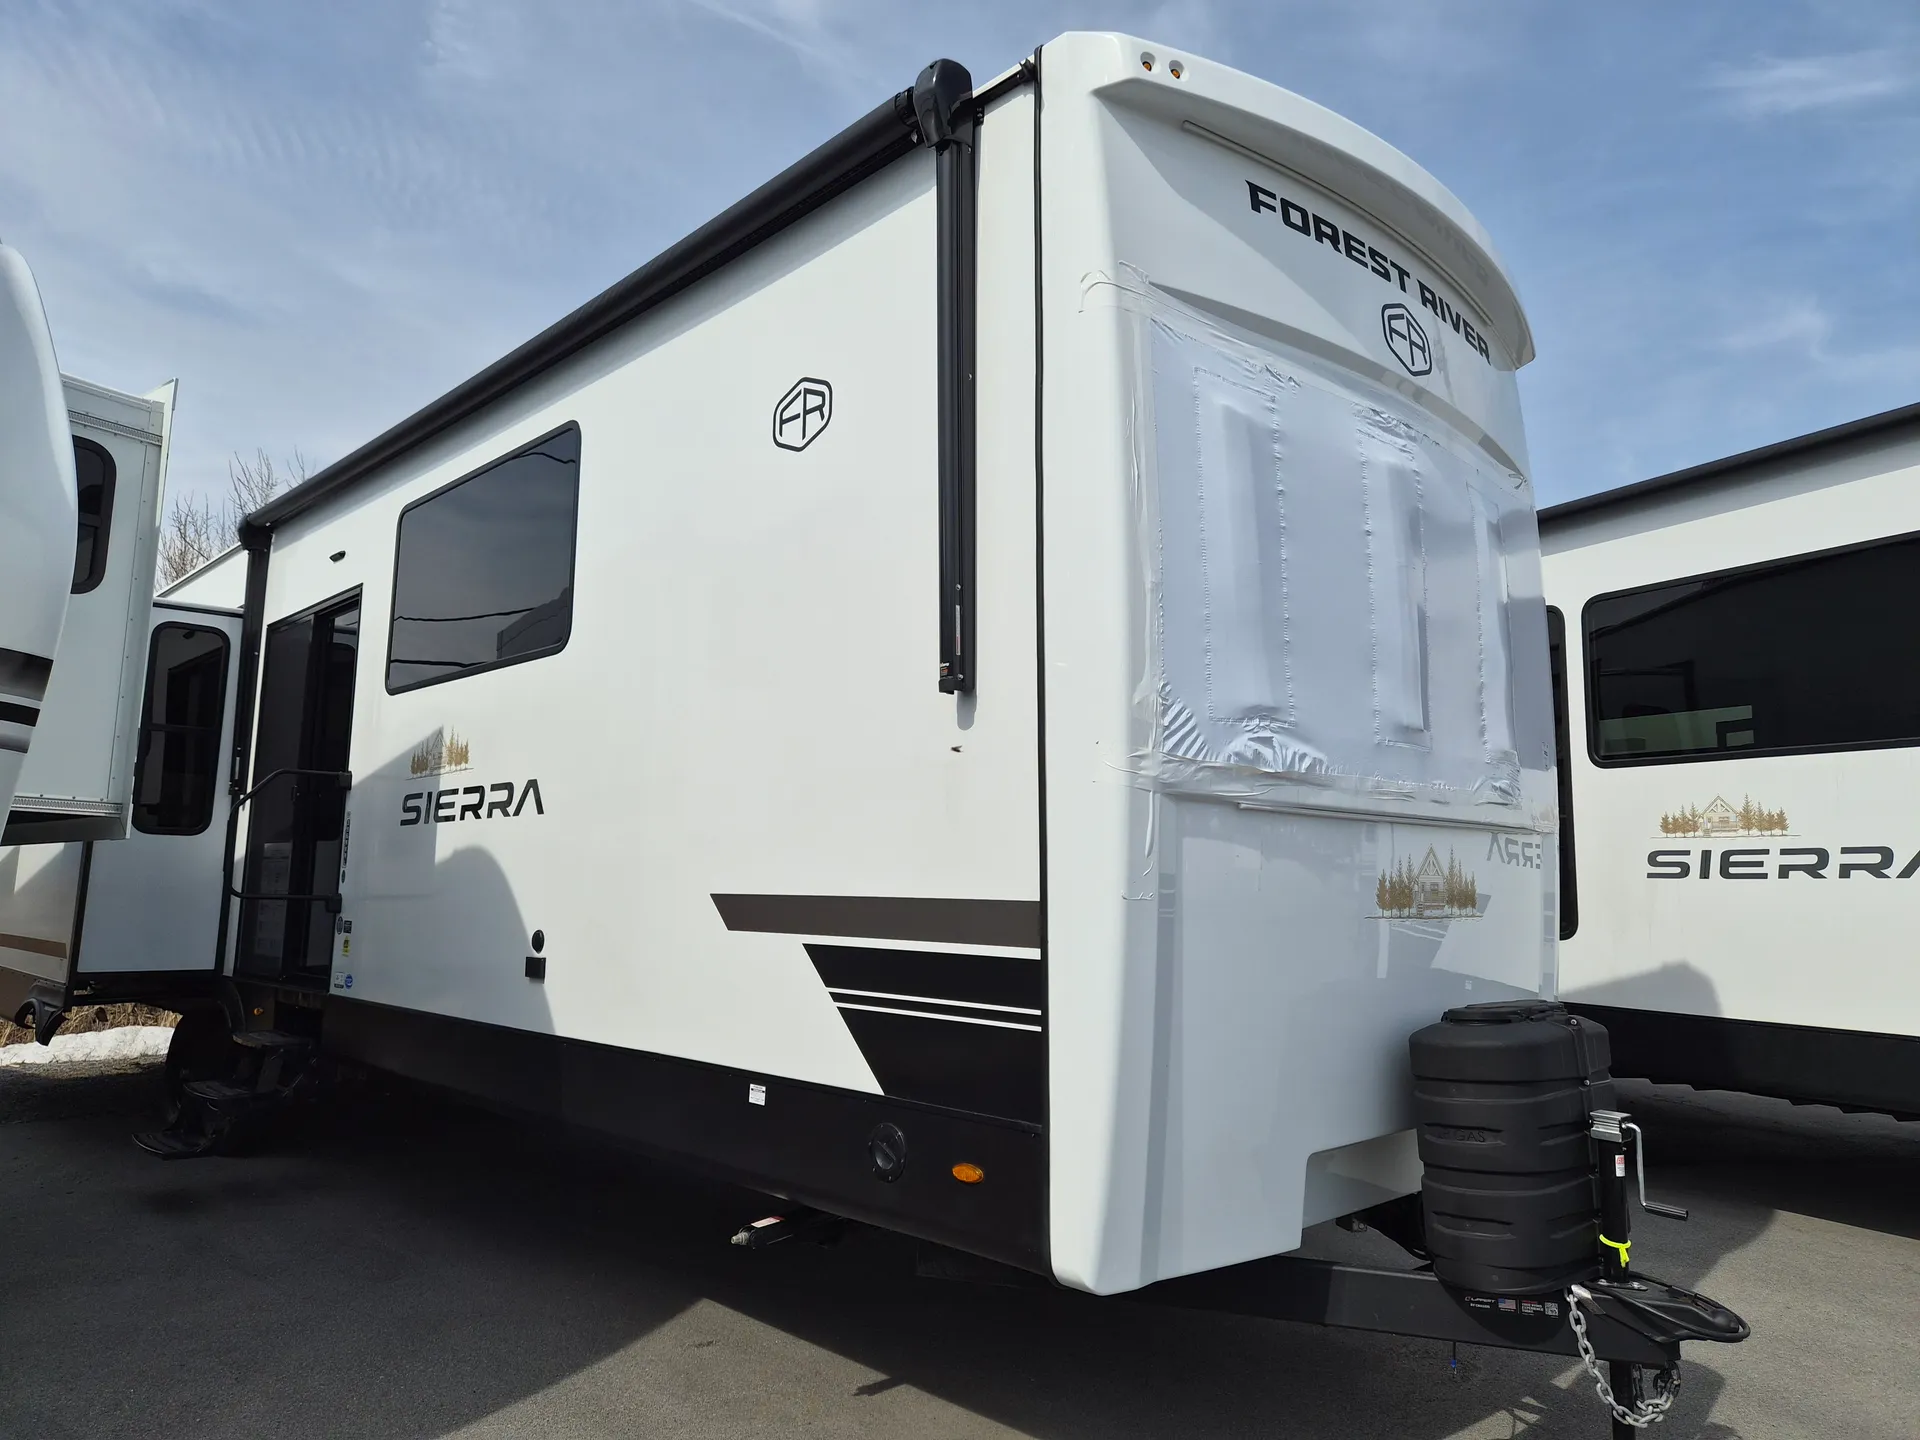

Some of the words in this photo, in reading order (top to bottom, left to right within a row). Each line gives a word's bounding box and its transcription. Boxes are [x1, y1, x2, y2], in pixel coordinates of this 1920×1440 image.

[1245, 179, 1410, 294] FOREST
[1416, 278, 1492, 367] RIVER
[400, 778, 545, 827] SIERRA
